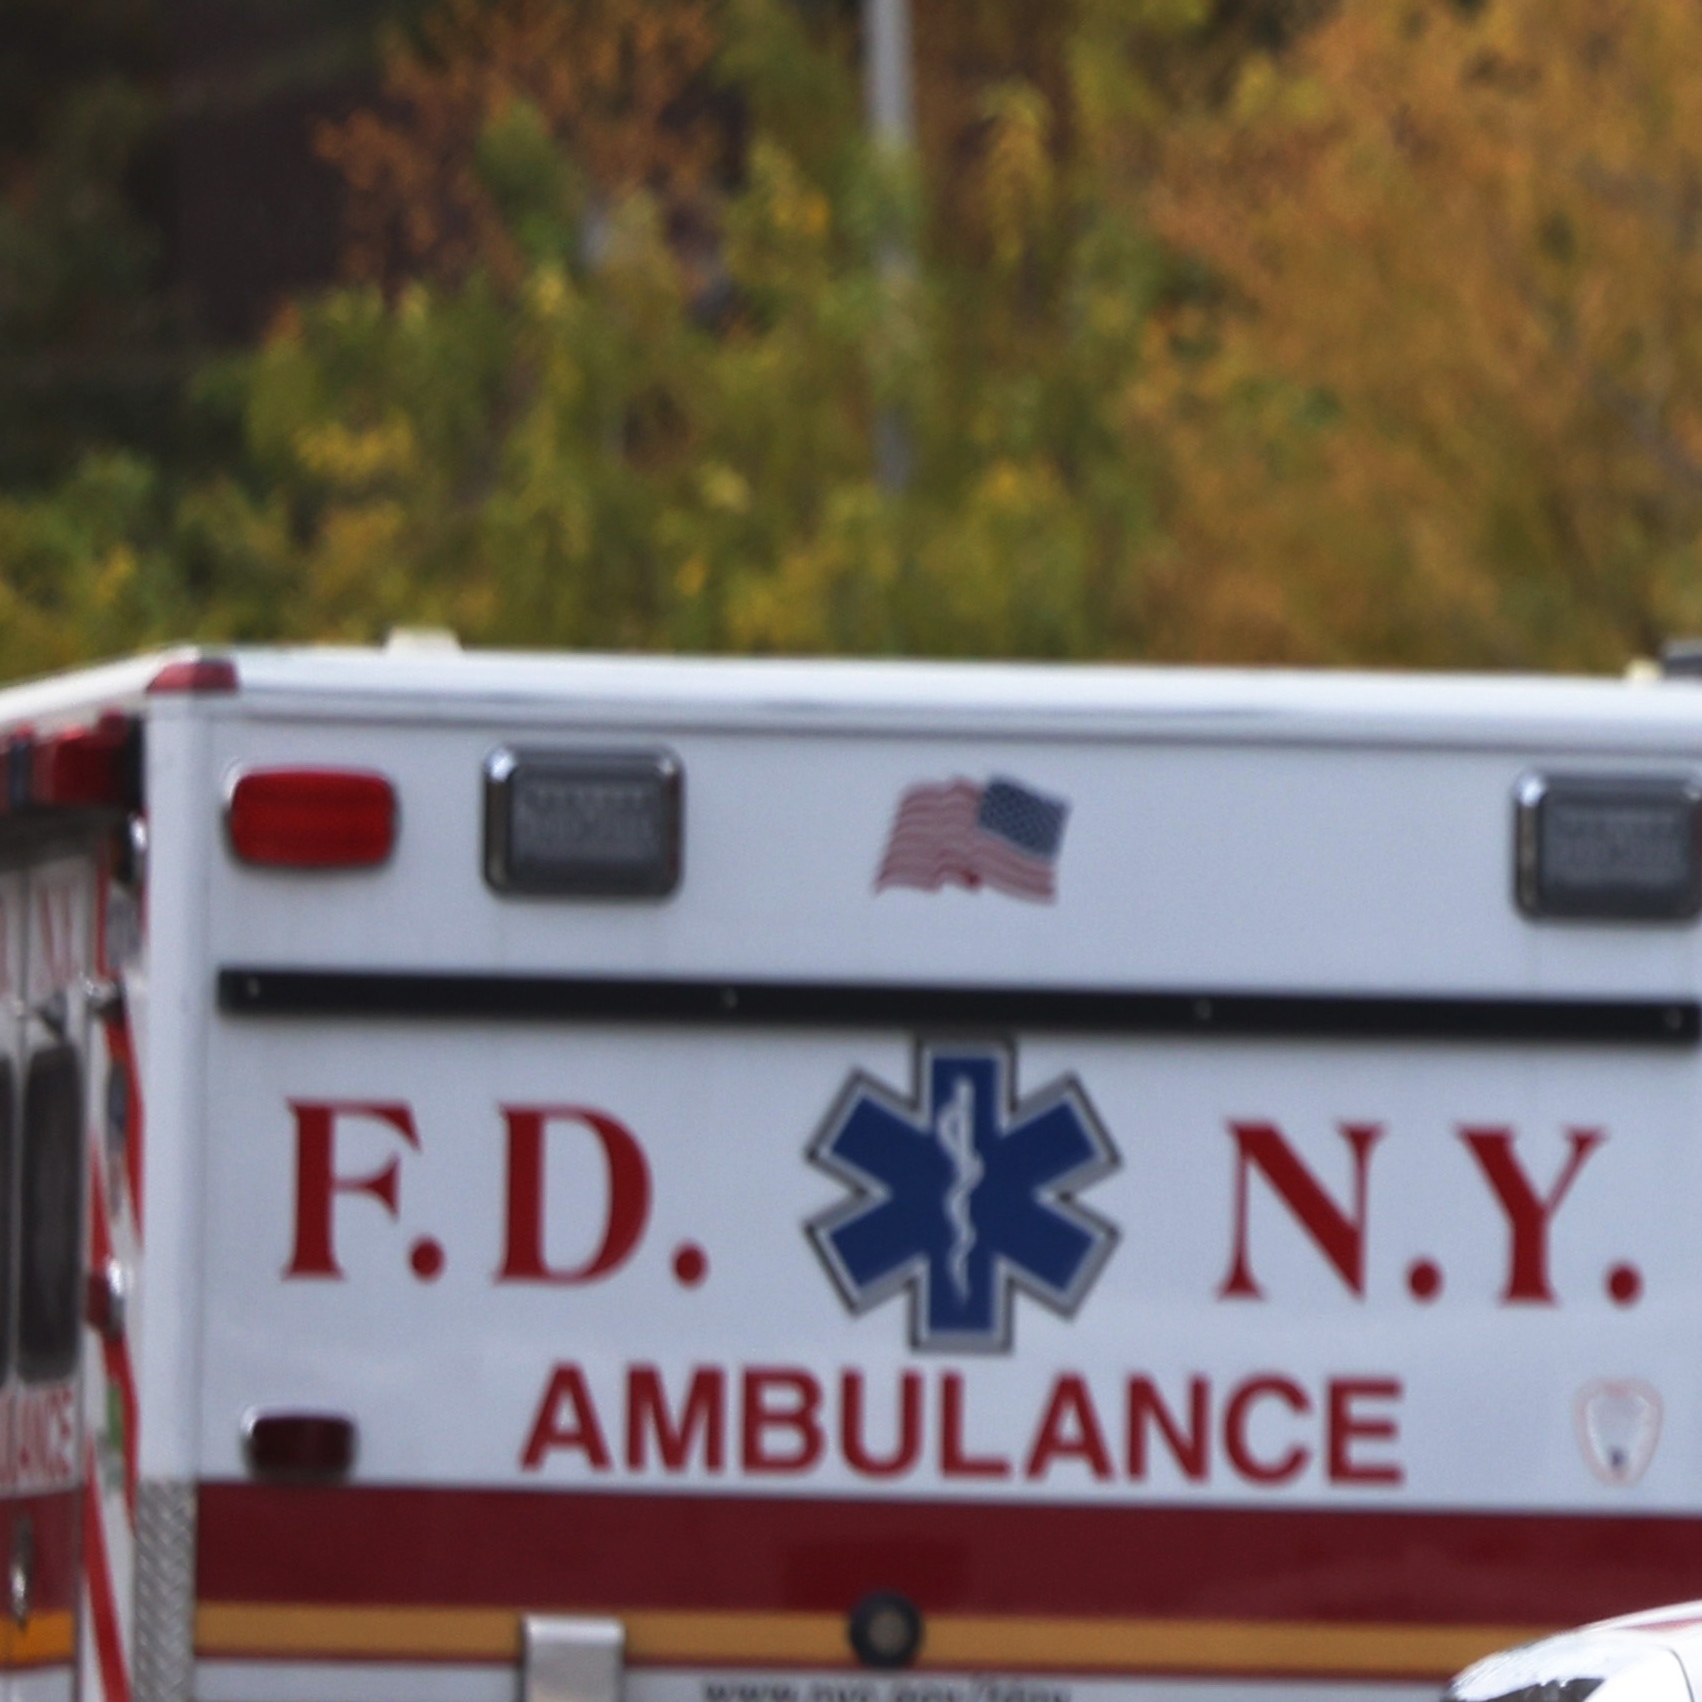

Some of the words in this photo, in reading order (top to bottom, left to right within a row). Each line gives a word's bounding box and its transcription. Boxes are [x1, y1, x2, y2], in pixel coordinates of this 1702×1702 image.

[281, 1096, 708, 1288] F.D.
[1216, 1119, 1644, 1309] N.Y.
[520, 1361, 1405, 1486] AMBULANCE
